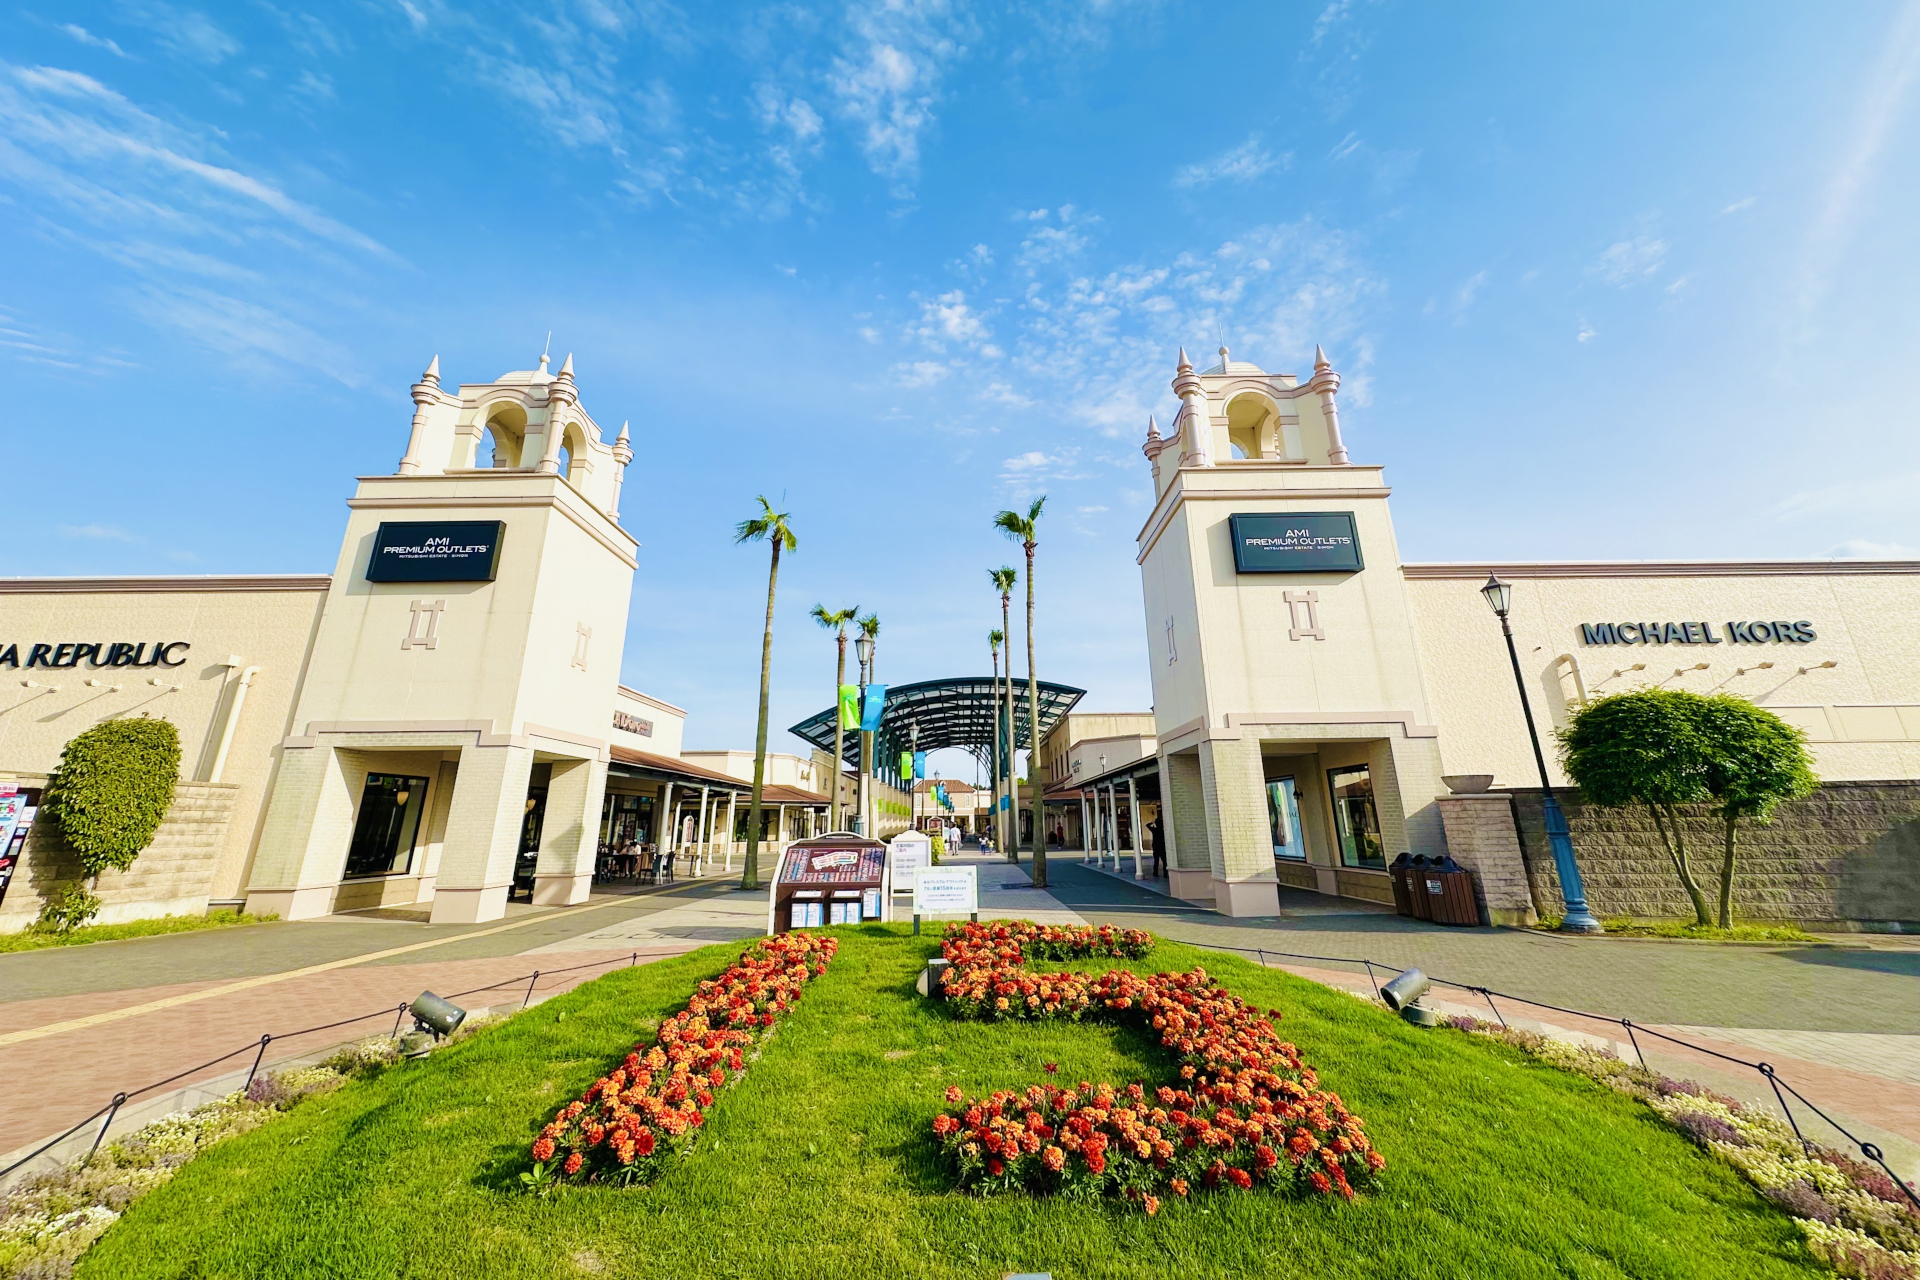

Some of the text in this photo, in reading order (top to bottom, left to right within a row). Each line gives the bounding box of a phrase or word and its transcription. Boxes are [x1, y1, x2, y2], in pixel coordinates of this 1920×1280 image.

[1285, 529, 1309, 537] AMI
[425, 537, 450, 546] AMI
[1246, 537, 1350, 546] PREMIUM OUTLETS
[437, 545, 487, 553] OUTLETS
[1581, 620, 1817, 645] MICHAEL KORS
[0, 641, 191, 668] A REPUBLIC
